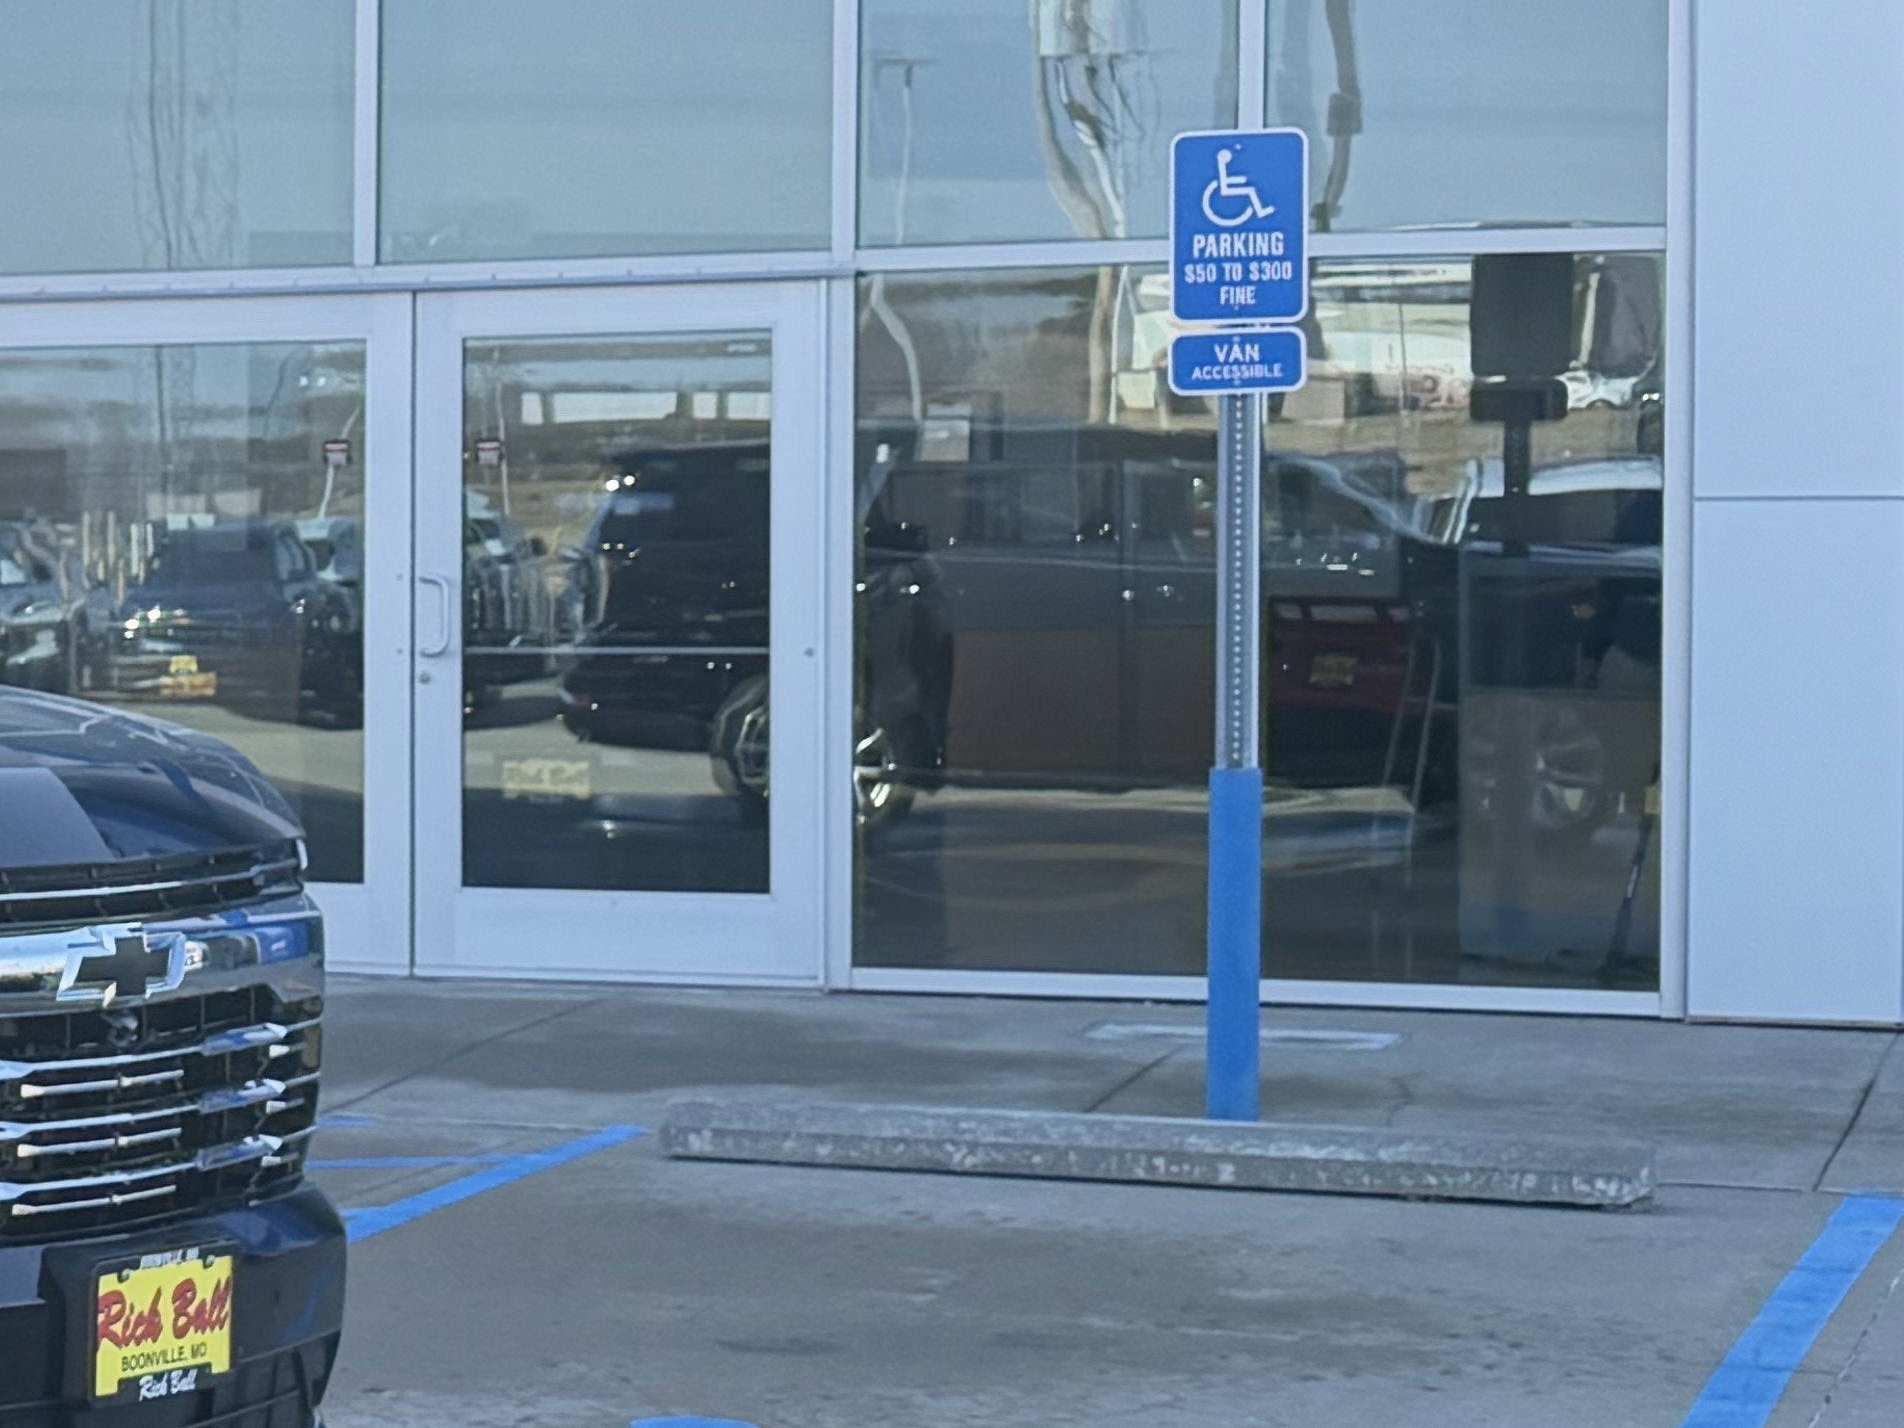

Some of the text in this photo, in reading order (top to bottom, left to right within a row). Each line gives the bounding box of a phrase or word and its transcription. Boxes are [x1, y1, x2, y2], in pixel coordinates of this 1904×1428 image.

[1193, 231, 1285, 259] PARKING
[1184, 261, 1292, 284] $50 TO $300
[1220, 286, 1256, 305] FINE
[1214, 343, 1260, 364] VAN
[1191, 362, 1283, 382] ACCESSIBLE
[97, 1276, 233, 1348] Rick Ball
[189, 1341, 208, 1359] MO
[138, 1369, 198, 1402] Rick Ball
